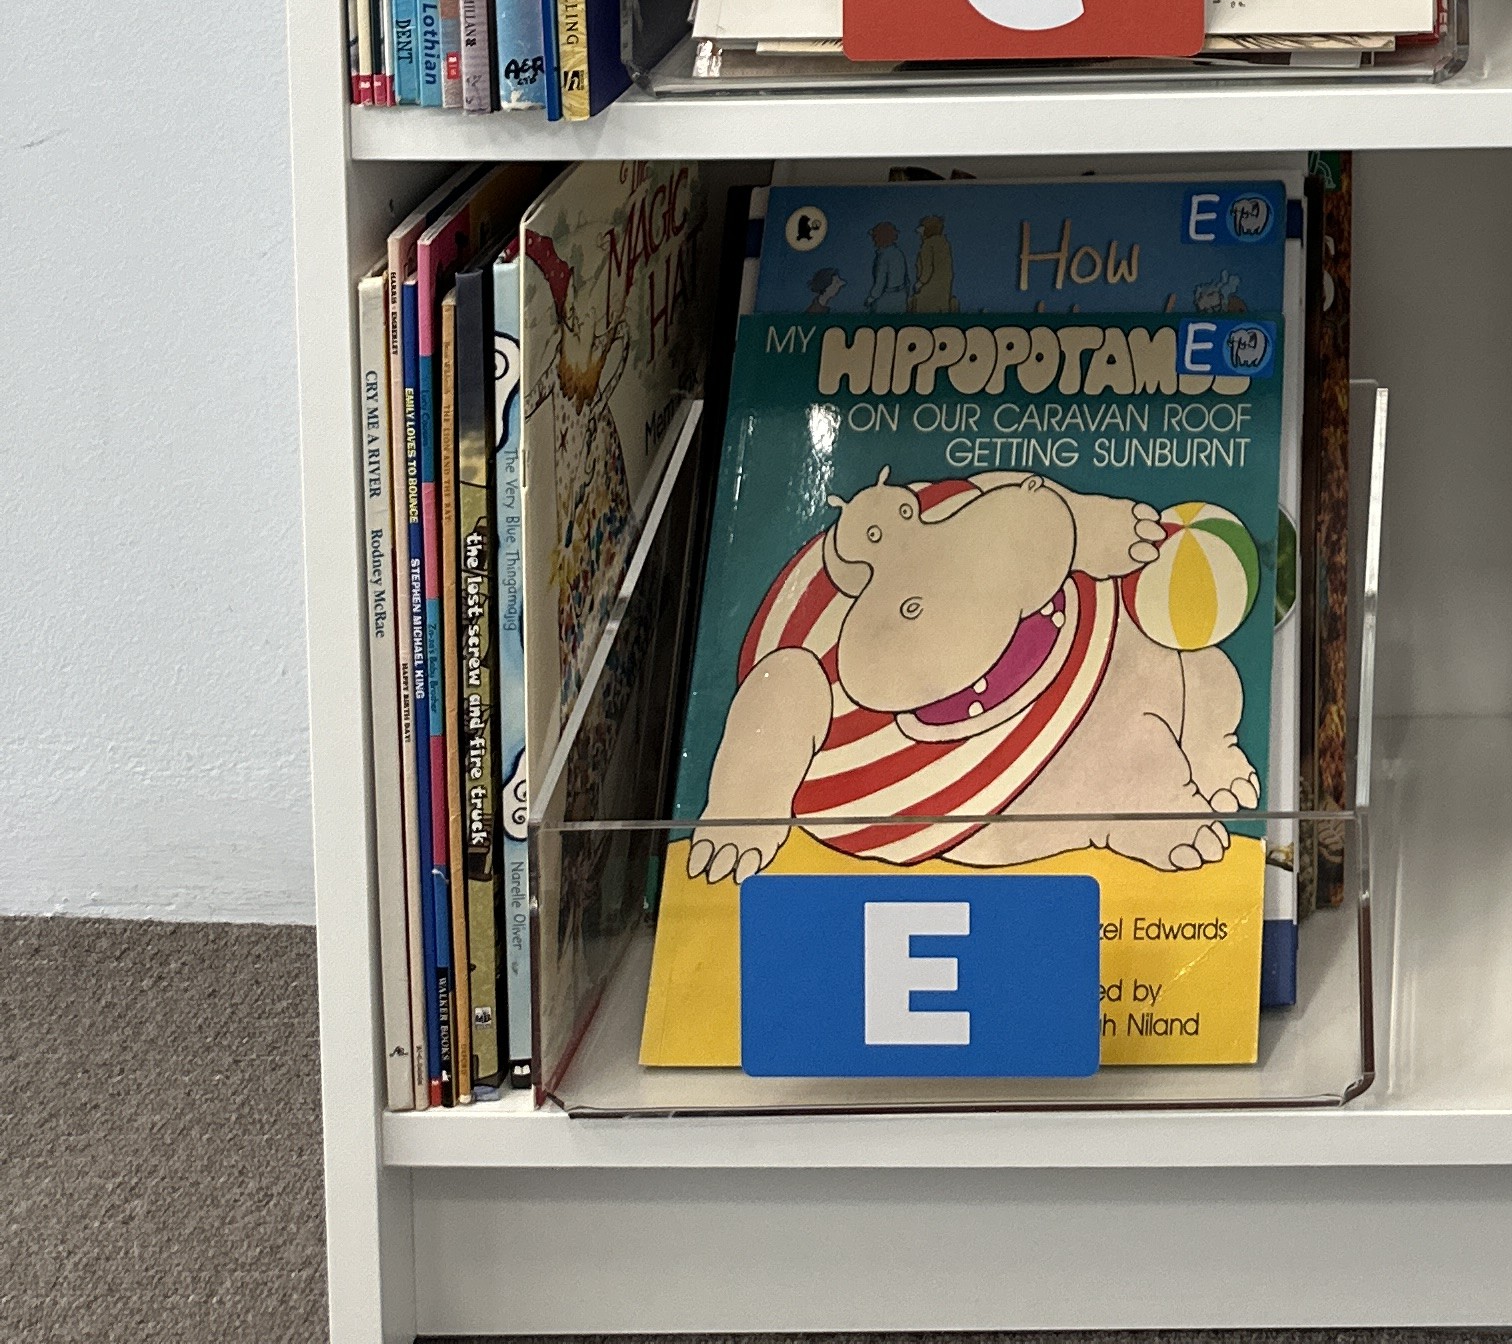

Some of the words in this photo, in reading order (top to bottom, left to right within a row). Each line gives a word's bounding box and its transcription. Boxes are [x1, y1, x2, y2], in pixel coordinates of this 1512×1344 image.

[396, 19, 412, 63] DENT
[422, 3, 438, 85] Lothian
[1188, 194, 1219, 241] E
[766, 326, 817, 353] MY
[818, 325, 1251, 395] HIPPOPOTAM
[1183, 323, 1217, 372] E
[365, 370, 379, 404] CRY
[405, 388, 415, 419] EMILY
[367, 408, 378, 430] ME
[849, 405, 898, 432] ON
[913, 405, 980, 432] OUR
[993, 405, 1149, 432] CARAVAN
[1162, 405, 1252, 432] ROOF
[368, 433, 379, 444] A
[406, 421, 416, 458] LOVES
[945, 440, 1079, 467] GETTING
[1093, 439, 1252, 467] SUNBURNT
[368, 449, 381, 498] RIVER
[407, 460, 417, 475] TO
[505, 449, 518, 472] The
[407, 478, 418, 523] BOUNCE
[503, 478, 518, 509] Very
[506, 516, 520, 543] Blue
[371, 529, 384, 585] Rodney
[466, 533, 483, 568] the
[410, 558, 422, 612] STEPHEN
[467, 577, 483, 617] lost
[503, 549, 520, 631] Thingamajig
[373, 589, 386, 638] McRae
[413, 615, 423, 666] MICHAEL
[467, 625, 482, 685] screw
[414, 670, 425, 698] KING
[469, 694, 484, 729] and
[470, 736, 485, 779] fire
[470, 786, 487, 845] truck
[511, 862, 525, 908] Narelle
[511, 914, 527, 950] Oliver
[1133, 916, 1228, 940] Edwards
[864, 902, 970, 1045] E
[1133, 978, 1162, 1007] by
[1127, 1012, 1199, 1036] Niland
